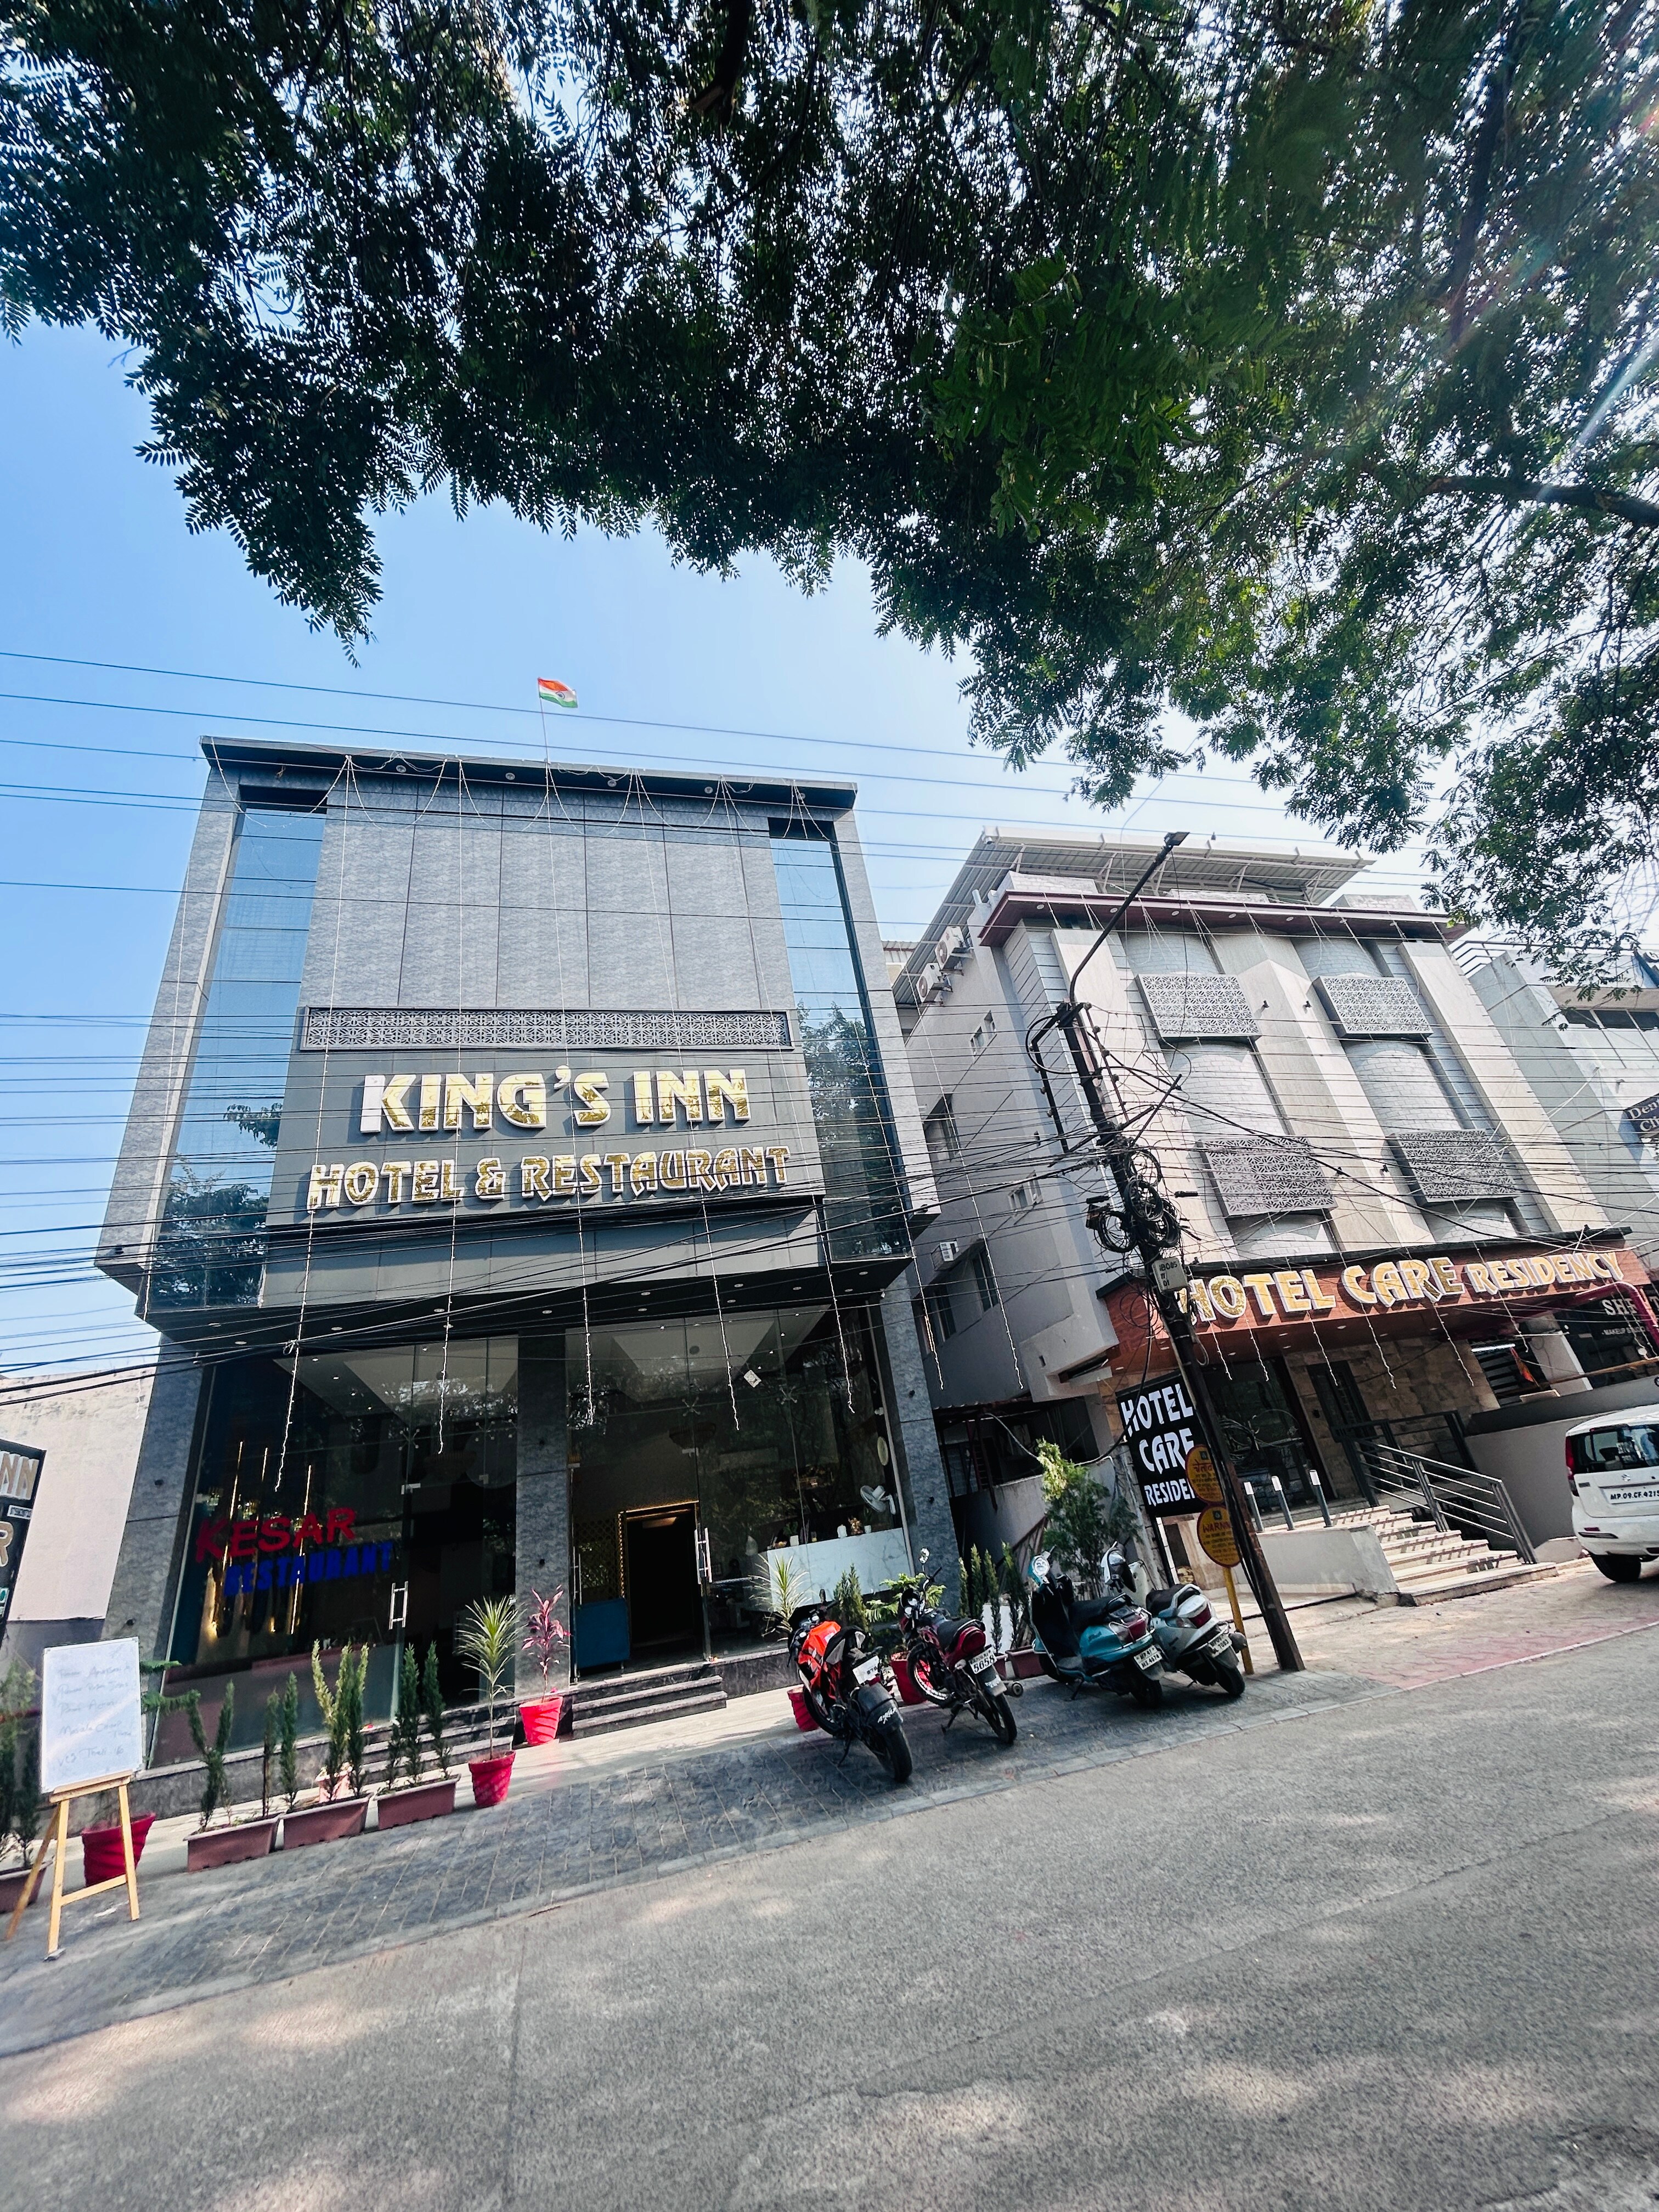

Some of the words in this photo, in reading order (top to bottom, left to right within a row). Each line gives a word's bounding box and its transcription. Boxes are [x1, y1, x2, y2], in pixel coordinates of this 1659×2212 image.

[359, 1065, 610, 1134] KING'S
[633, 1068, 752, 1125] INN
[307, 1158, 466, 1214] HOTEL
[475, 1157, 505, 1201] &
[520, 1146, 791, 1204] RESTAURANT
[1174, 1269, 1338, 1325] HOTEL
[1341, 1257, 1465, 1307] CARE
[1465, 1251, 1625, 1295] RESIDENCY
[1121, 1383, 1193, 1437] HOTEL
[196, 1507, 357, 1563] KESAR
[224, 1541, 394, 1597] RESTAURANT
